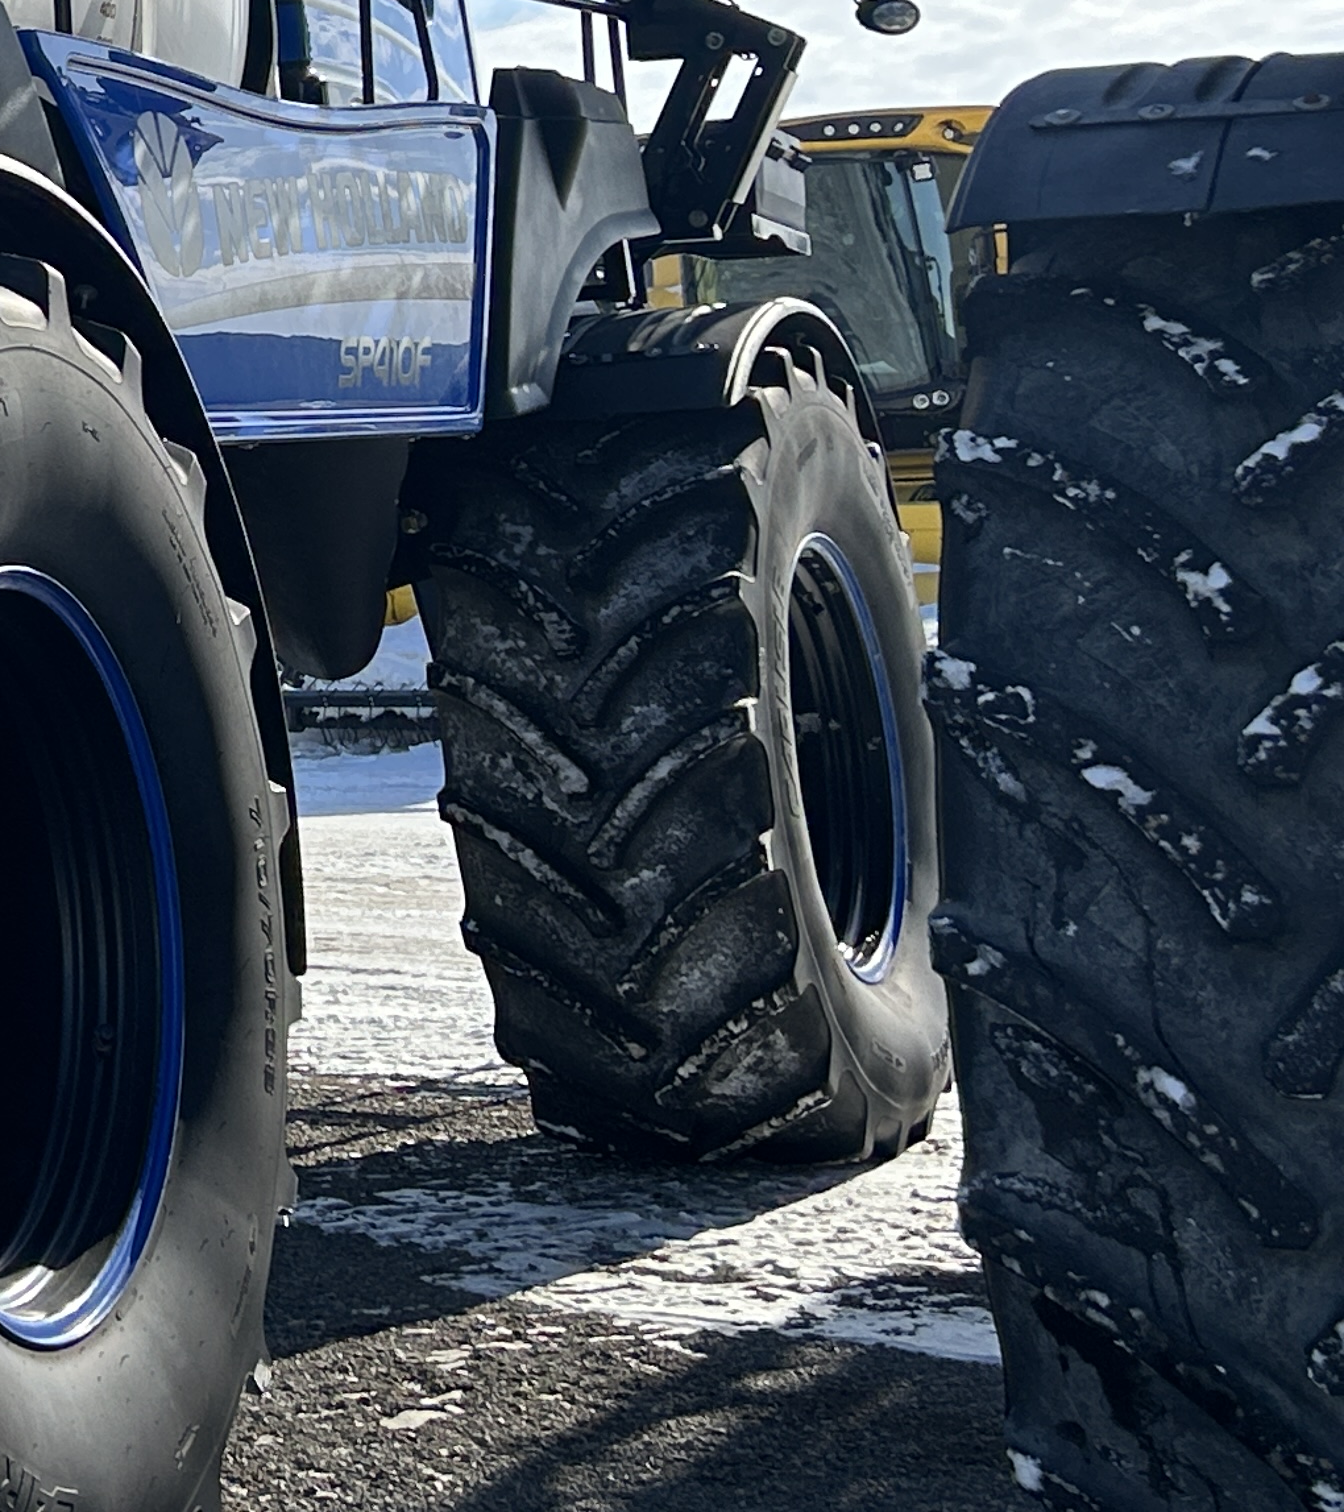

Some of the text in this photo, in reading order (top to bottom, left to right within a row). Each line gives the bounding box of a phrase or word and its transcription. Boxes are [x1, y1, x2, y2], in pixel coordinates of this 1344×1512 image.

[214, 171, 470, 267] NEW HOLLAND
[337, 335, 433, 389] SP410F
